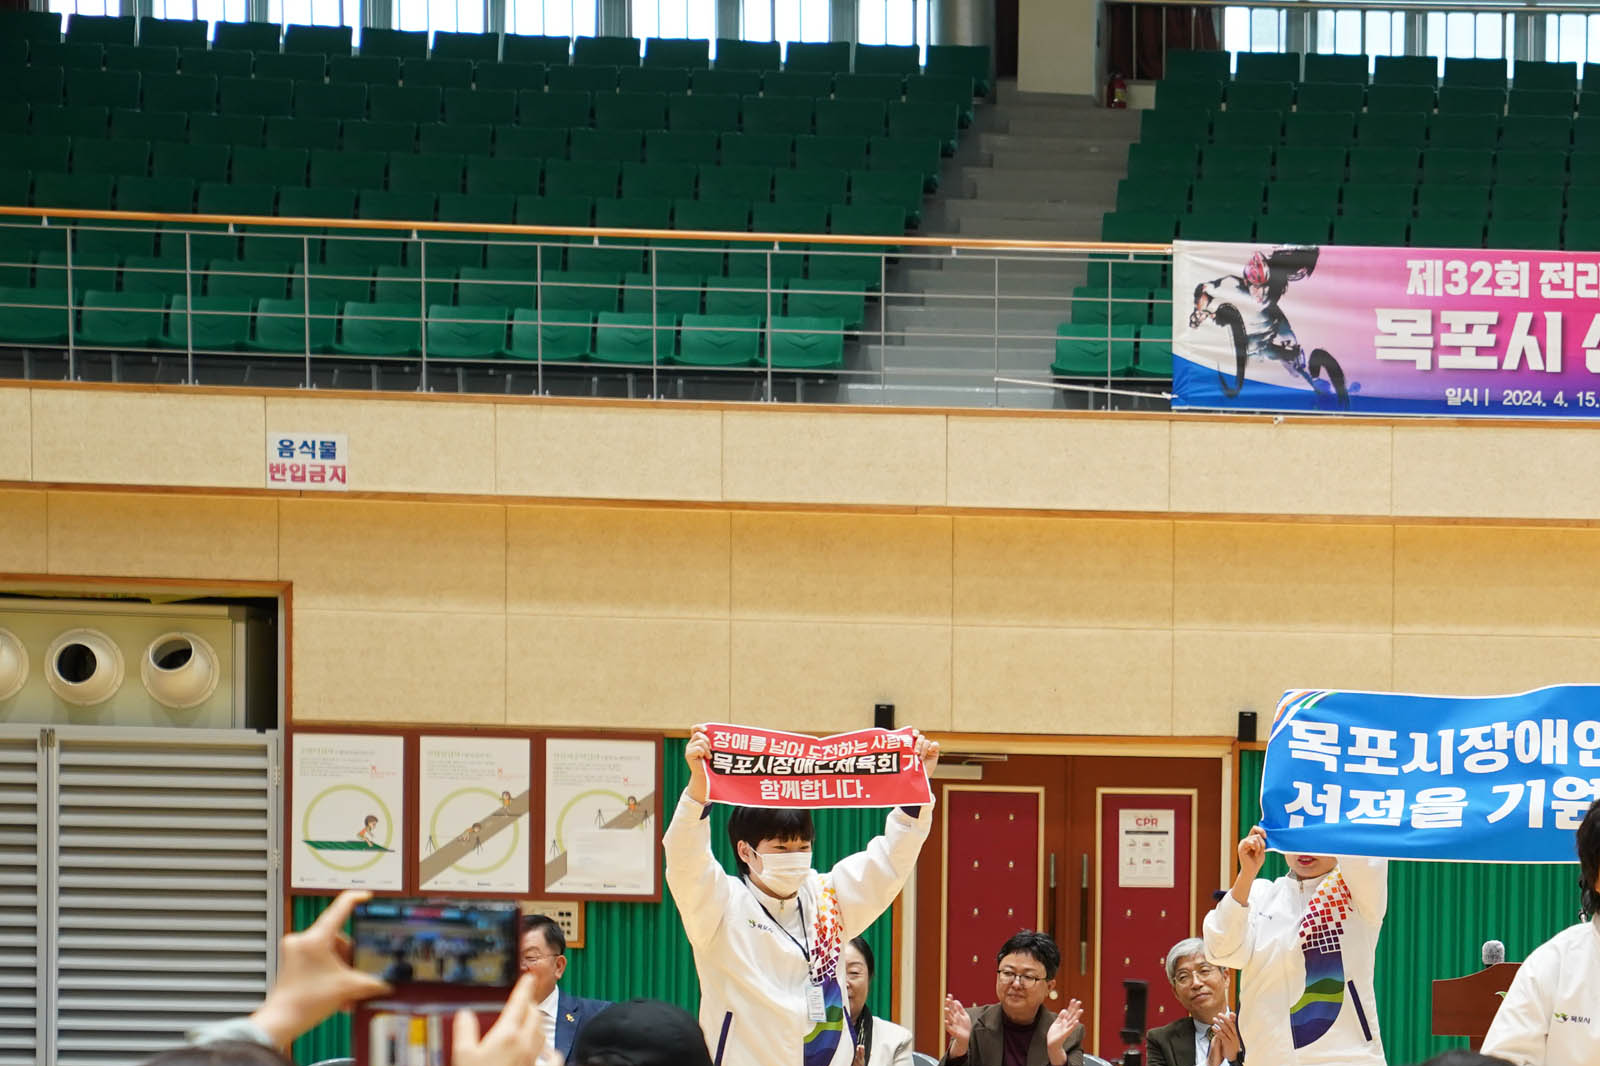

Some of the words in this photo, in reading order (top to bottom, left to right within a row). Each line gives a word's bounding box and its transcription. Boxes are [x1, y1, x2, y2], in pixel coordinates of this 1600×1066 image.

[1406, 260, 1530, 298] 제32회
[1374, 309, 1563, 374] 목포시
[1445, 388, 1479, 406] 일시
[1502, 390, 1547, 408] 2024.
[1553, 390, 1569, 408] 4.
[277, 439, 336, 460] 음식물
[268, 463, 346, 485] 반입금지
[713, 731, 767, 753] 장애를
[769, 738, 804, 757] 넘어
[806, 740, 868, 760] 도전하는
[902, 754, 920, 772] 가
[760, 779, 871, 801] 함께합니다.
[1135, 817, 1158, 827] CPR
